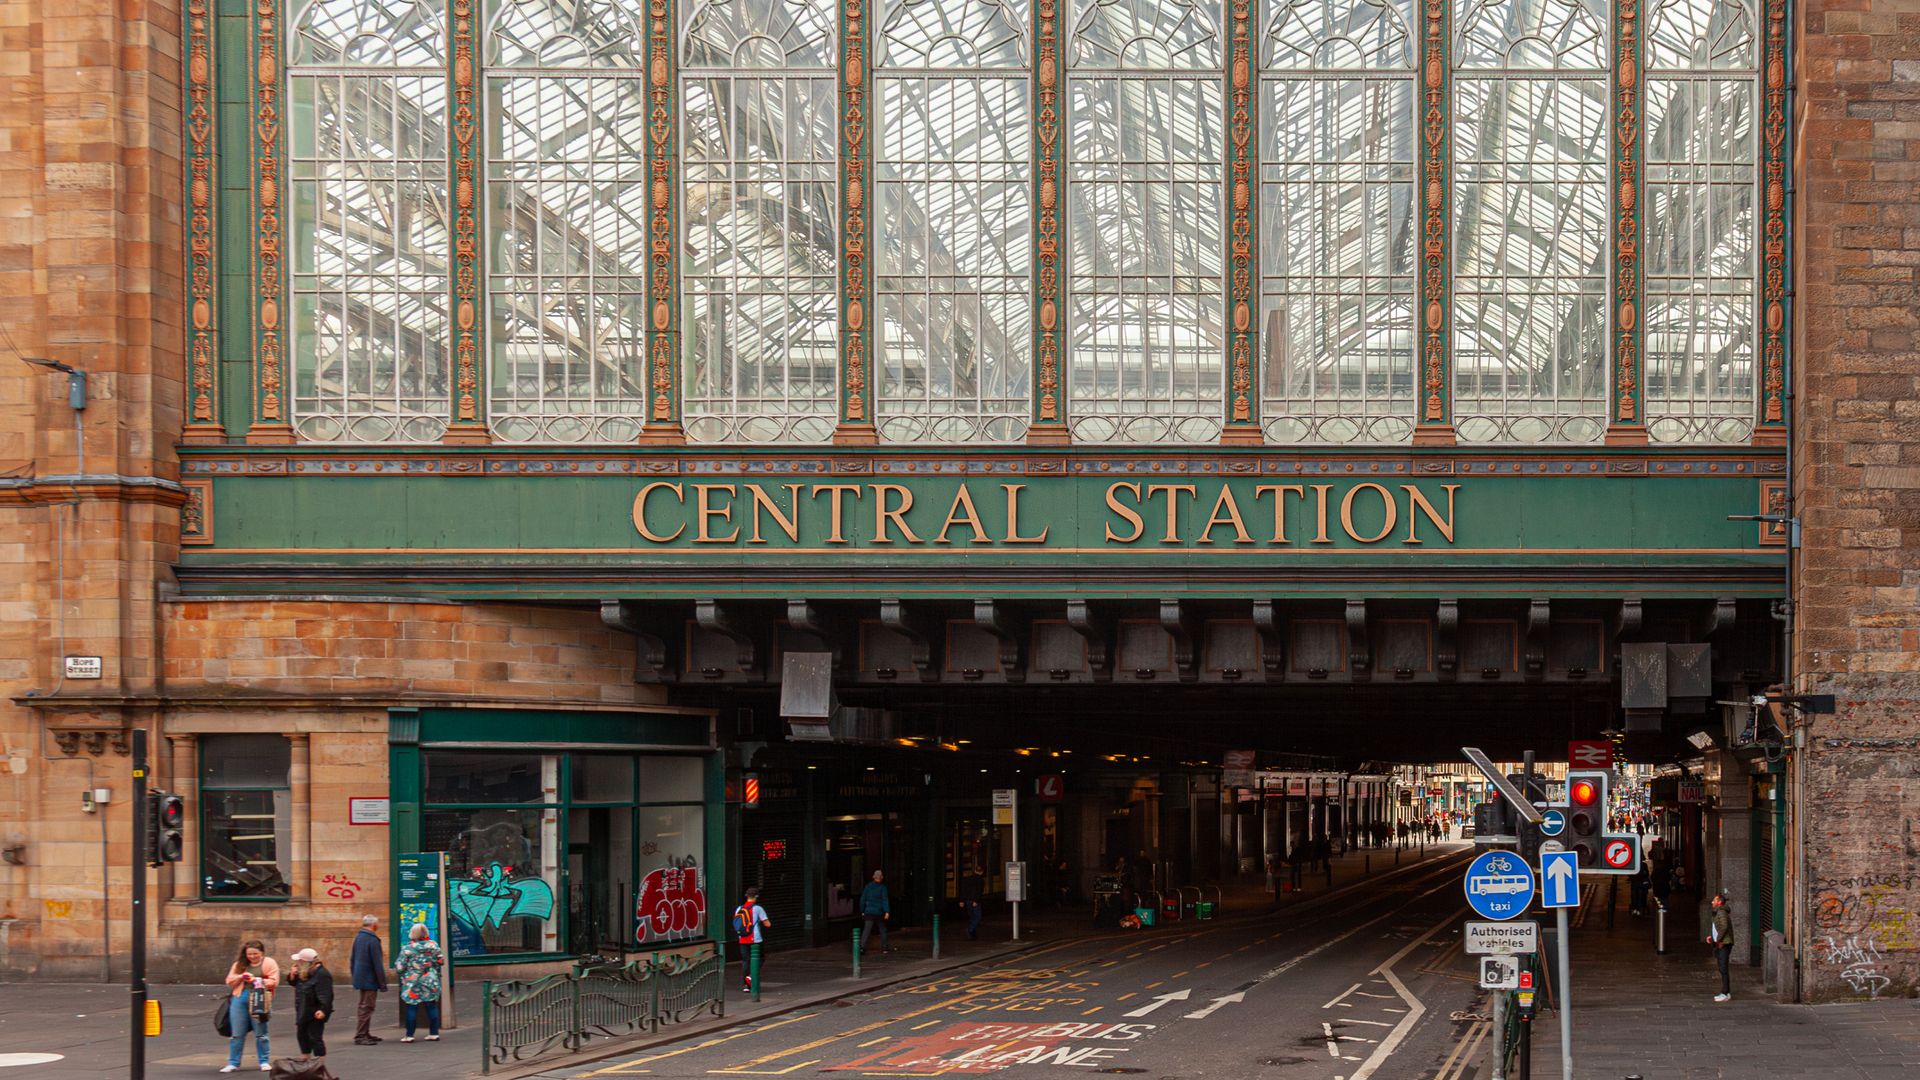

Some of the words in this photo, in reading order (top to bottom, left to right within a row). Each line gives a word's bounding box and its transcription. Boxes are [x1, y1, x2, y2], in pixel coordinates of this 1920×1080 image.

[632, 481, 1049, 544] CENTRAL
[1105, 481, 1461, 544] STATION
[1490, 902, 1511, 912] taxi
[1471, 927, 1532, 936] Authorised
[1479, 939, 1524, 948] vehicles
[1032, 1022, 1156, 1041] BUS
[951, 1044, 1129, 1067] LANE
